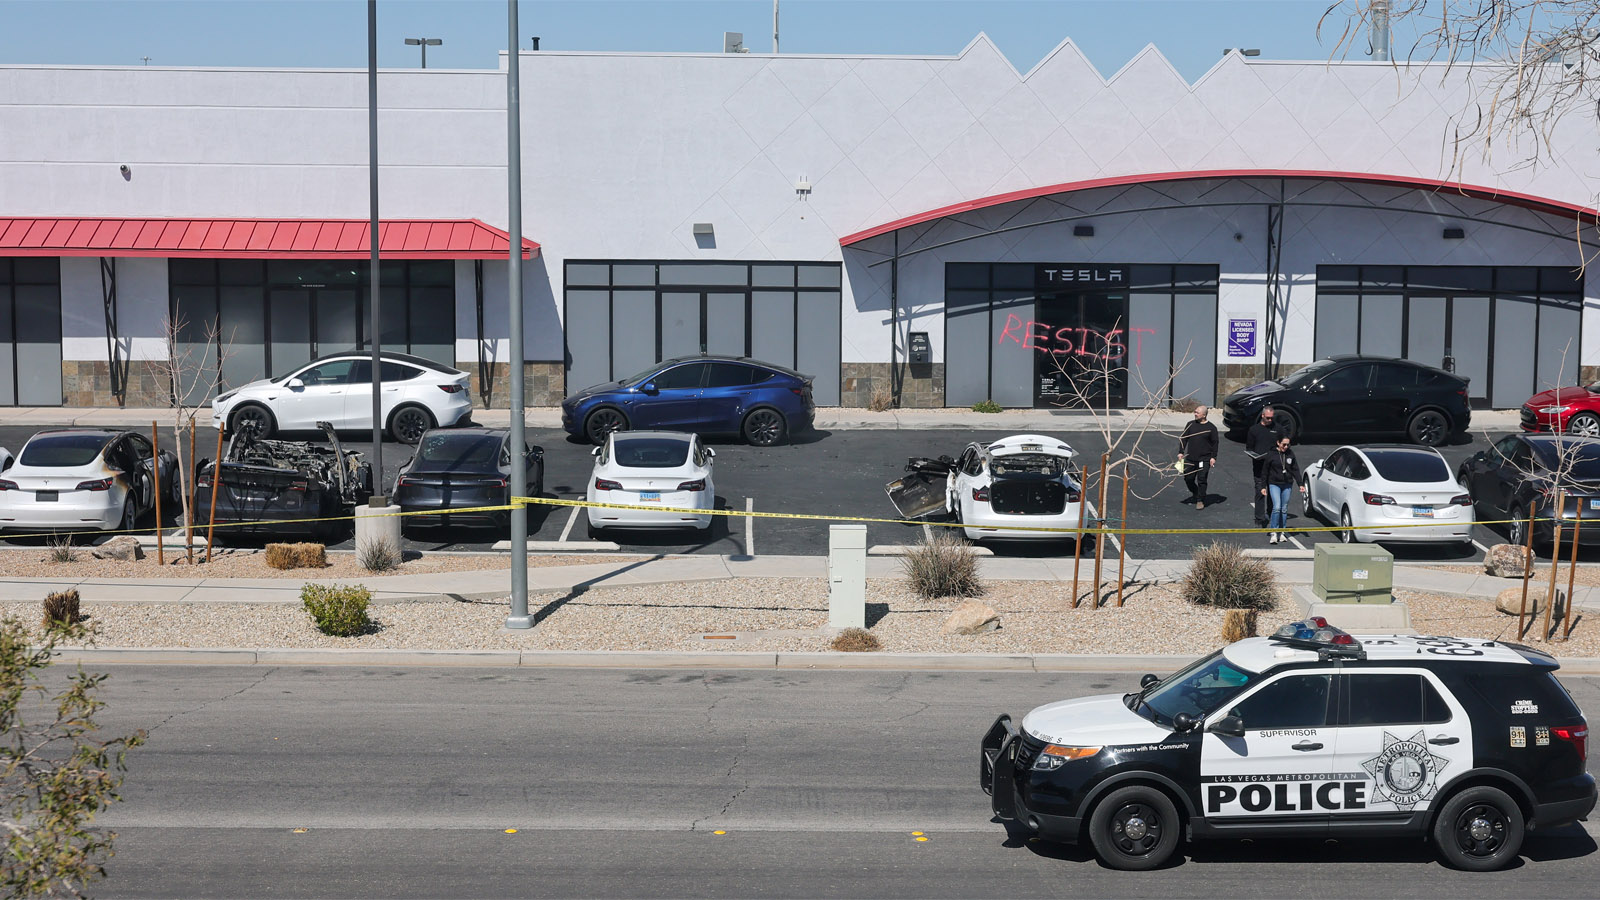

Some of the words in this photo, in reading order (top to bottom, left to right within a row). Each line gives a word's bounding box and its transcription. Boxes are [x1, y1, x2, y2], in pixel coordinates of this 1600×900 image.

[1044, 269, 1122, 281] TESLA
[998, 313, 1156, 366] RESIST
[1259, 729, 1317, 738] SUPERVISOR
[1158, 742, 1190, 750] Community
[1377, 742, 1435, 773] METROPOLITAN
[1276, 773, 1357, 781] METROPOLITAN
[1208, 781, 1366, 812] POLICE
[1388, 791, 1425, 804] POLICE
